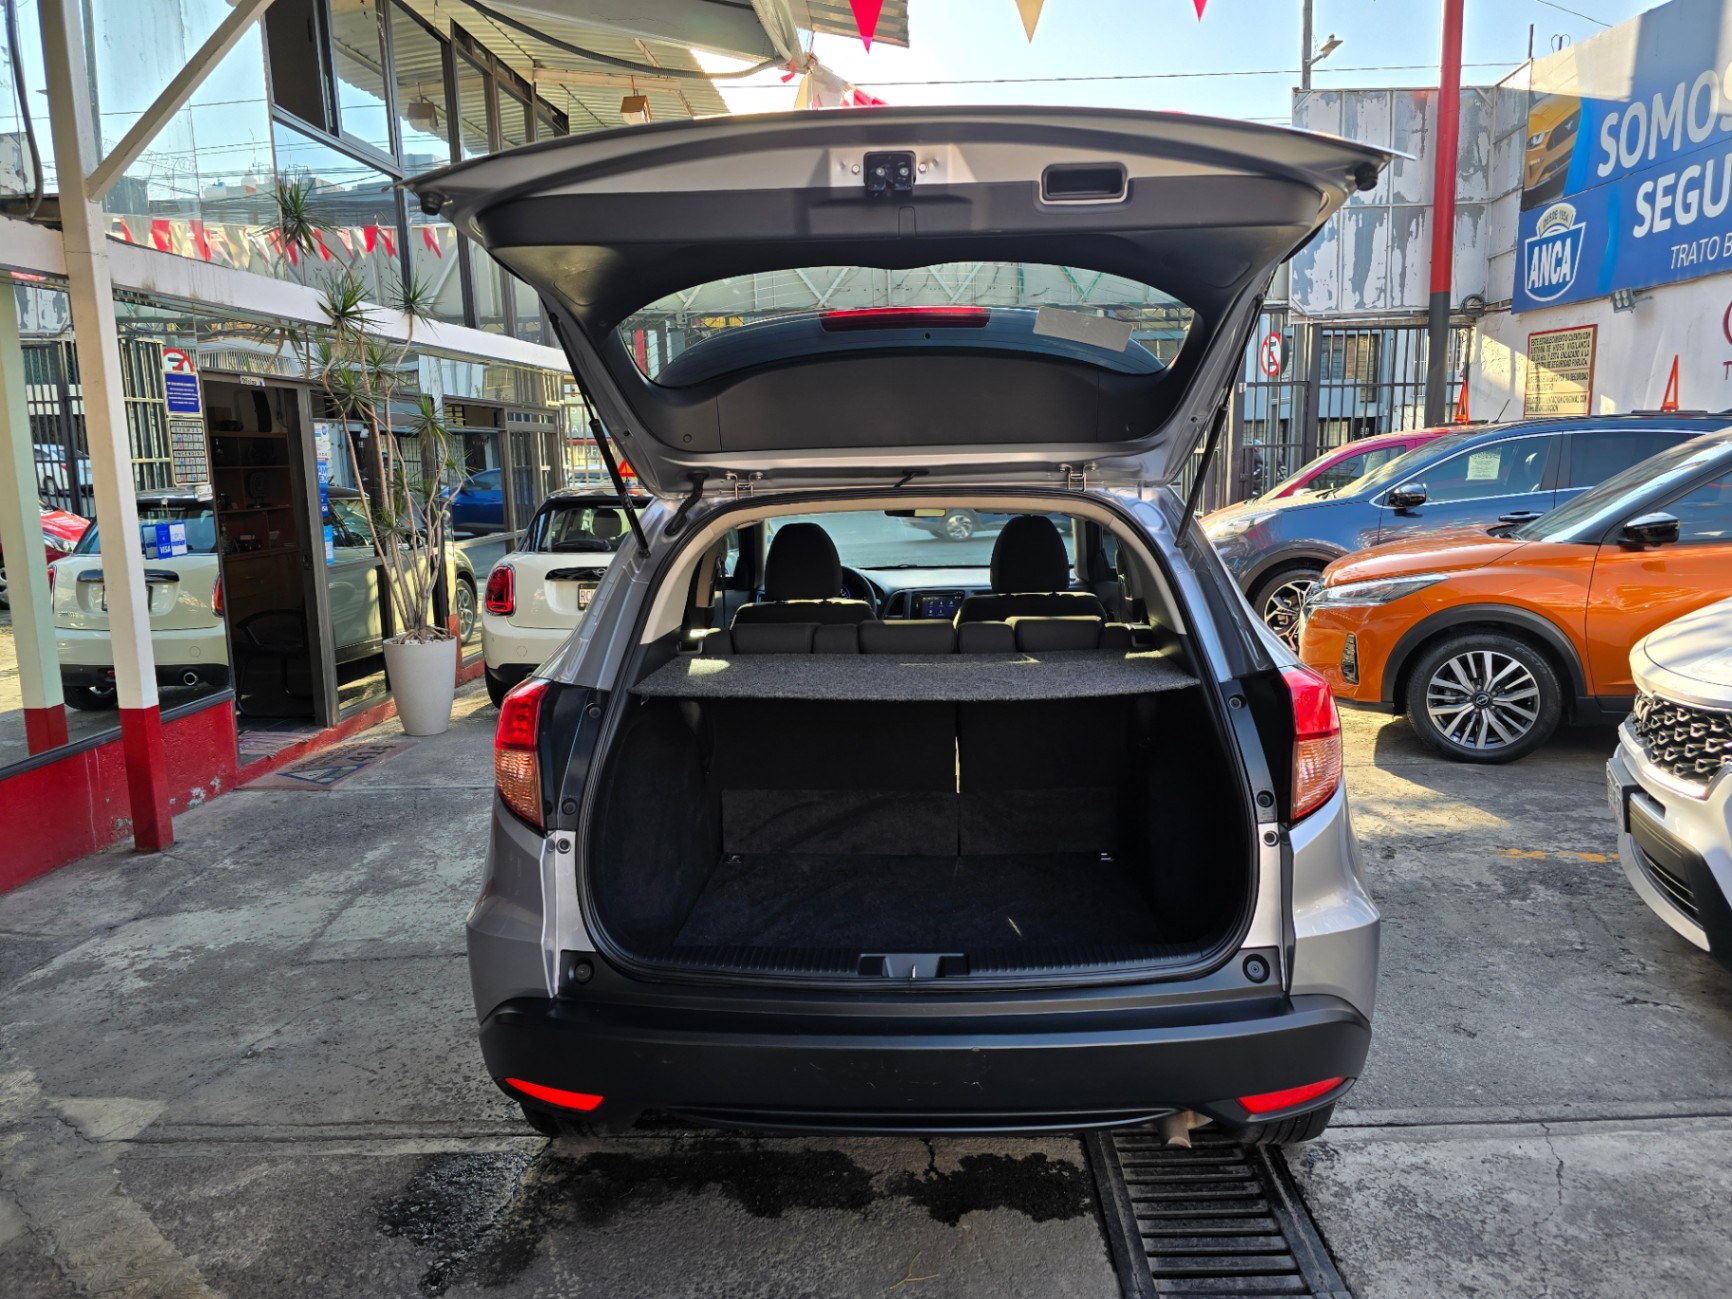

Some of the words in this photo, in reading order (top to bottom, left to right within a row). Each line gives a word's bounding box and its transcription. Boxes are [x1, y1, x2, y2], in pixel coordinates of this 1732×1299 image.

[1632, 153, 1732, 238] SEGU
[1527, 238, 1571, 289] ANCA
[1670, 236, 1720, 270] TRATO
